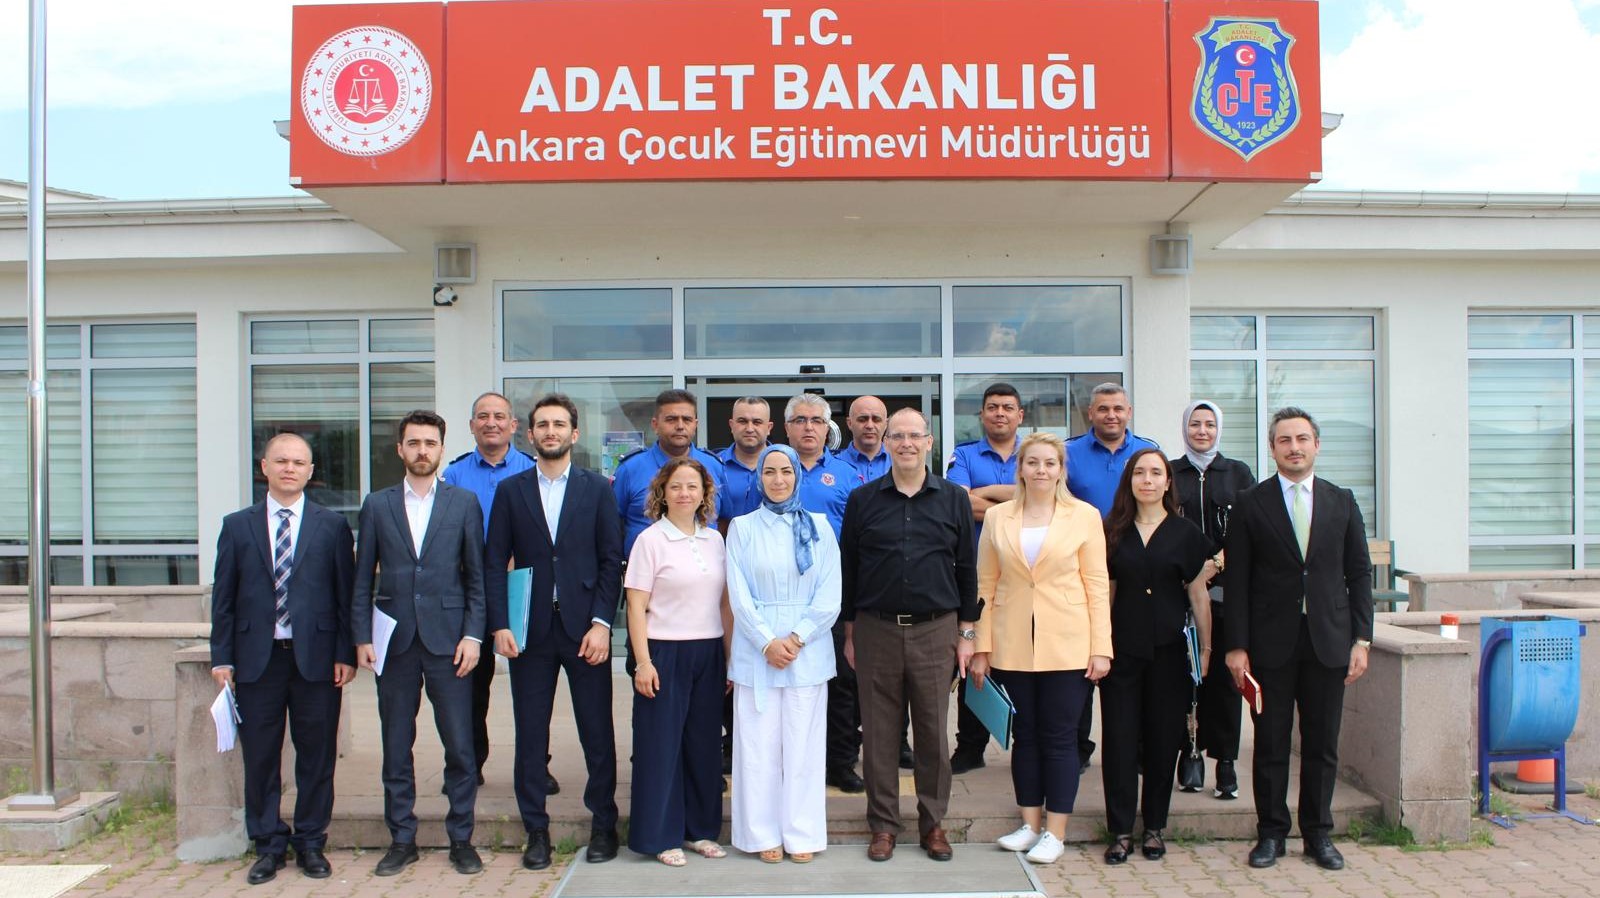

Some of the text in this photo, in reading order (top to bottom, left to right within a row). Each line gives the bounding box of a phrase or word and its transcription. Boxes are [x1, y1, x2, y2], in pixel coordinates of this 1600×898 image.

[762, 8, 853, 46] T.C.
[326, 50, 372, 91] CUMHURİYETİ
[374, 52, 403, 76] ADALET
[519, 53, 1096, 113] ADALET BAKANLIĞI
[385, 78, 406, 124] BAKANLIĞI
[1216, 69, 1273, 117] CTE
[466, 124, 1150, 168] Ankara Çocuk Eğitimevi Müdürlüğü
[1236, 121, 1256, 129] 1923
